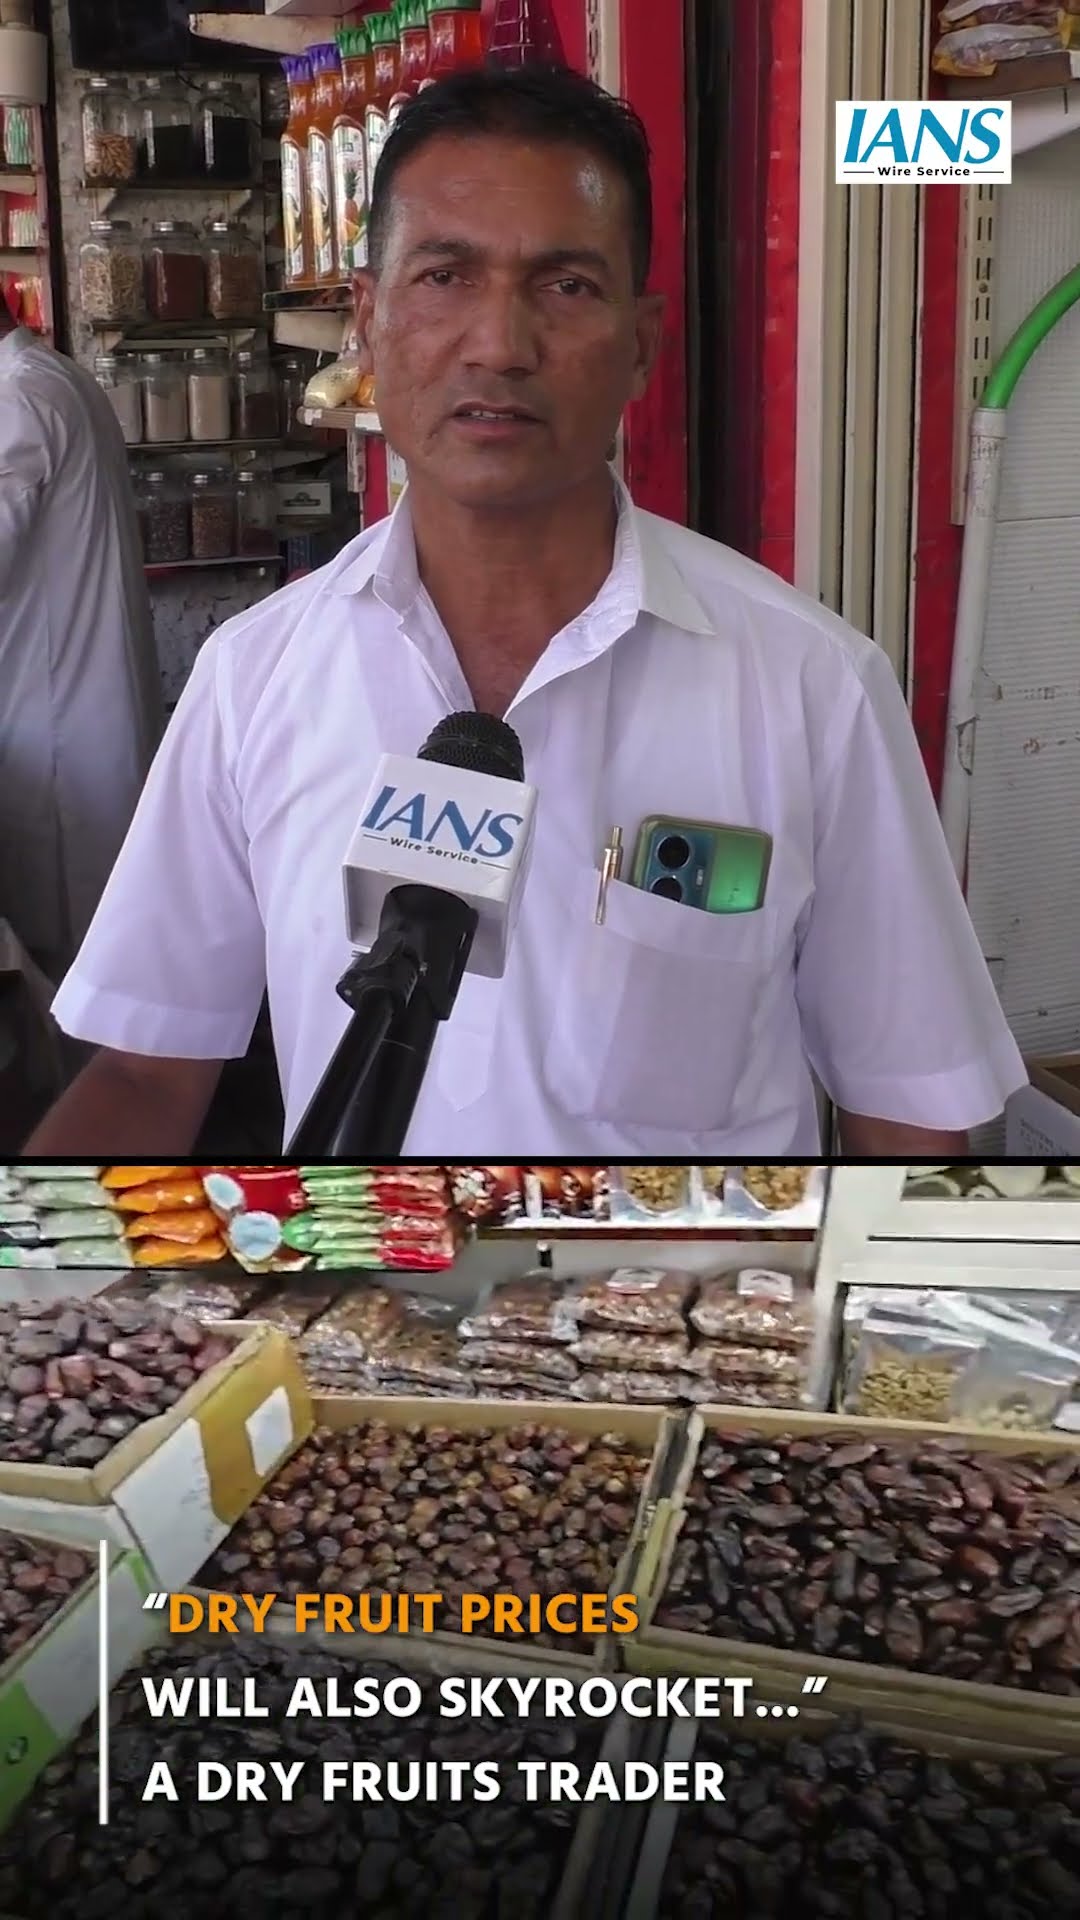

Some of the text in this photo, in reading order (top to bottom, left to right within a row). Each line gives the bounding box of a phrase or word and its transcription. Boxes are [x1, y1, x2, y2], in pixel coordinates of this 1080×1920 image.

[361, 785, 524, 858] IANS
[390, 836, 479, 865] Wire Service
